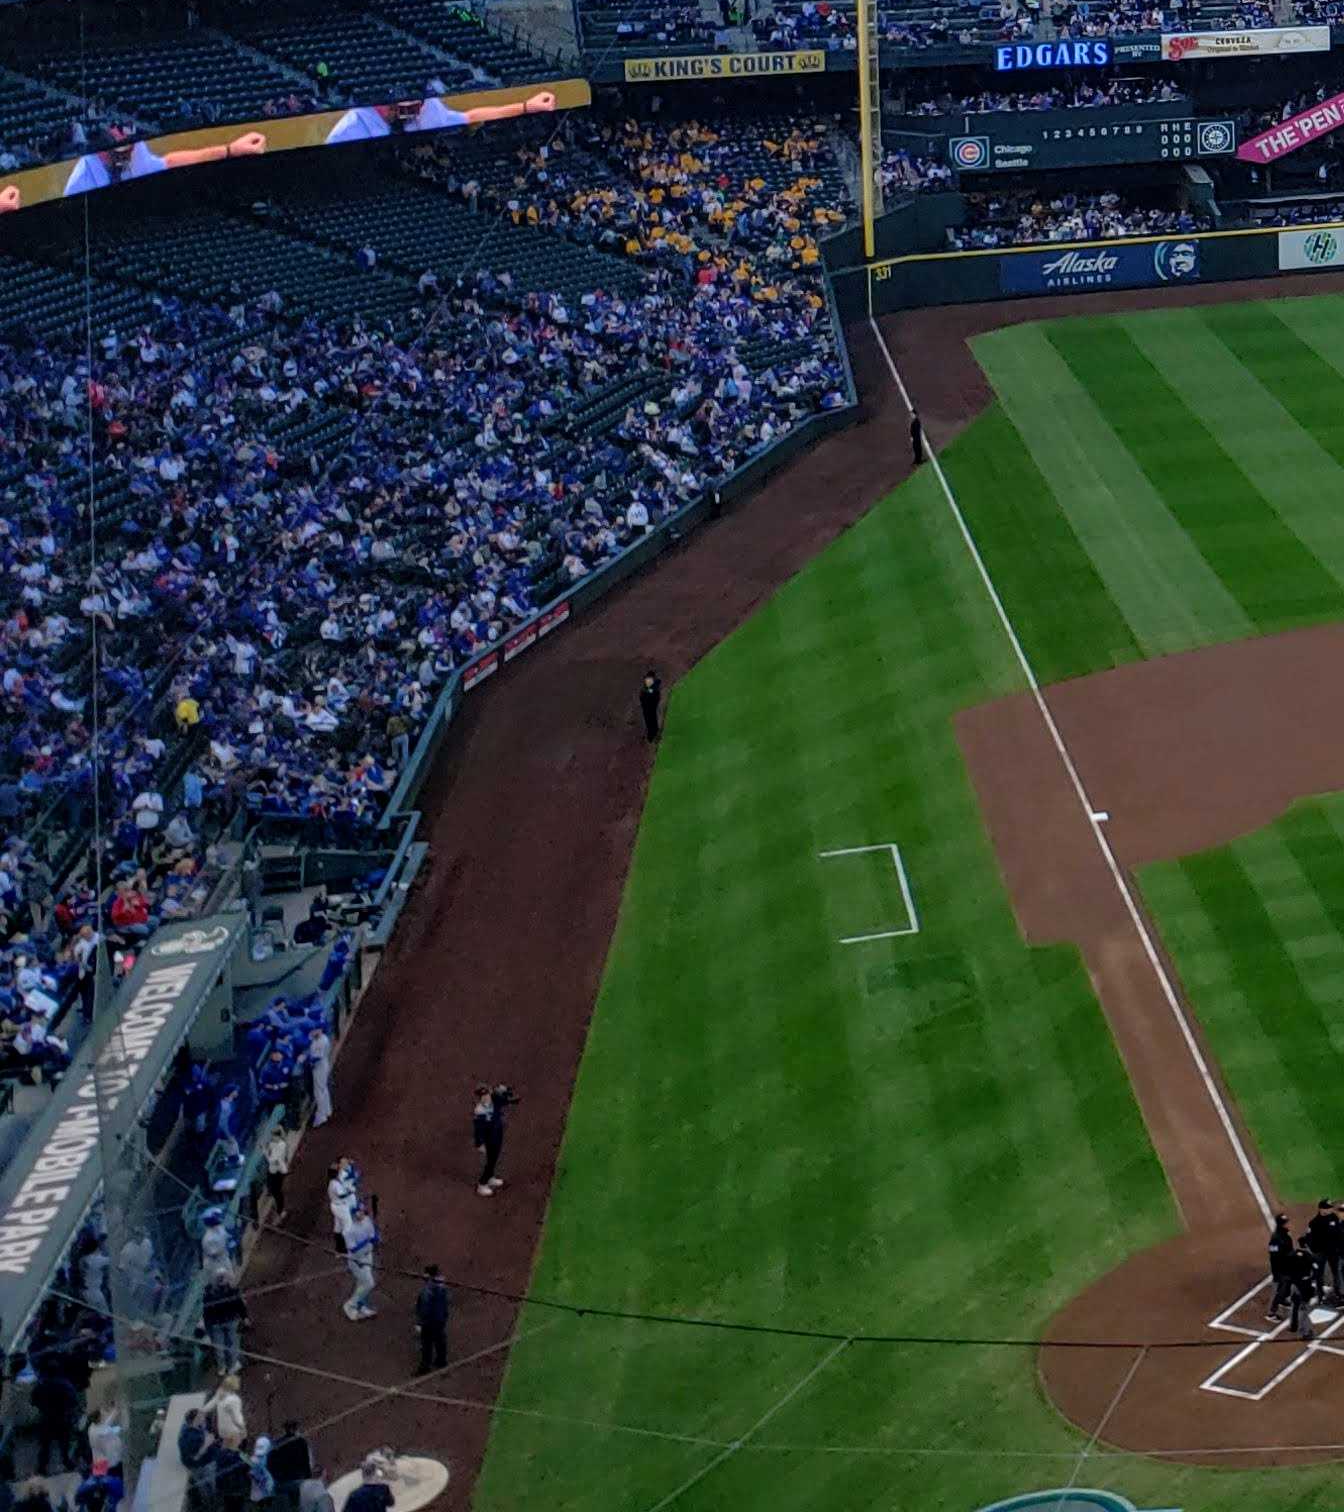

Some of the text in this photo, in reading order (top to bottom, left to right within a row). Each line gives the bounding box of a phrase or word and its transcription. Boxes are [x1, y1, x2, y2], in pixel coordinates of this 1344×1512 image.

[996, 41, 1108, 70] EDGAR'S
[1114, 44, 1161, 53] PRESENTED
[654, 55, 796, 77] KING'S COURT
[1161, 135, 1168, 144] 0
[1173, 134, 1180, 143] 0
[1184, 134, 1191, 143] 0
[1255, 125, 1300, 159] THE
[1161, 148, 1168, 157] 0
[1173, 148, 1180, 157] 0
[1185, 147, 1191, 156] 0
[1043, 251, 1119, 275] Alaska
[874, 266, 892, 282] 331
[1047, 273, 1112, 287] AIRLINES
